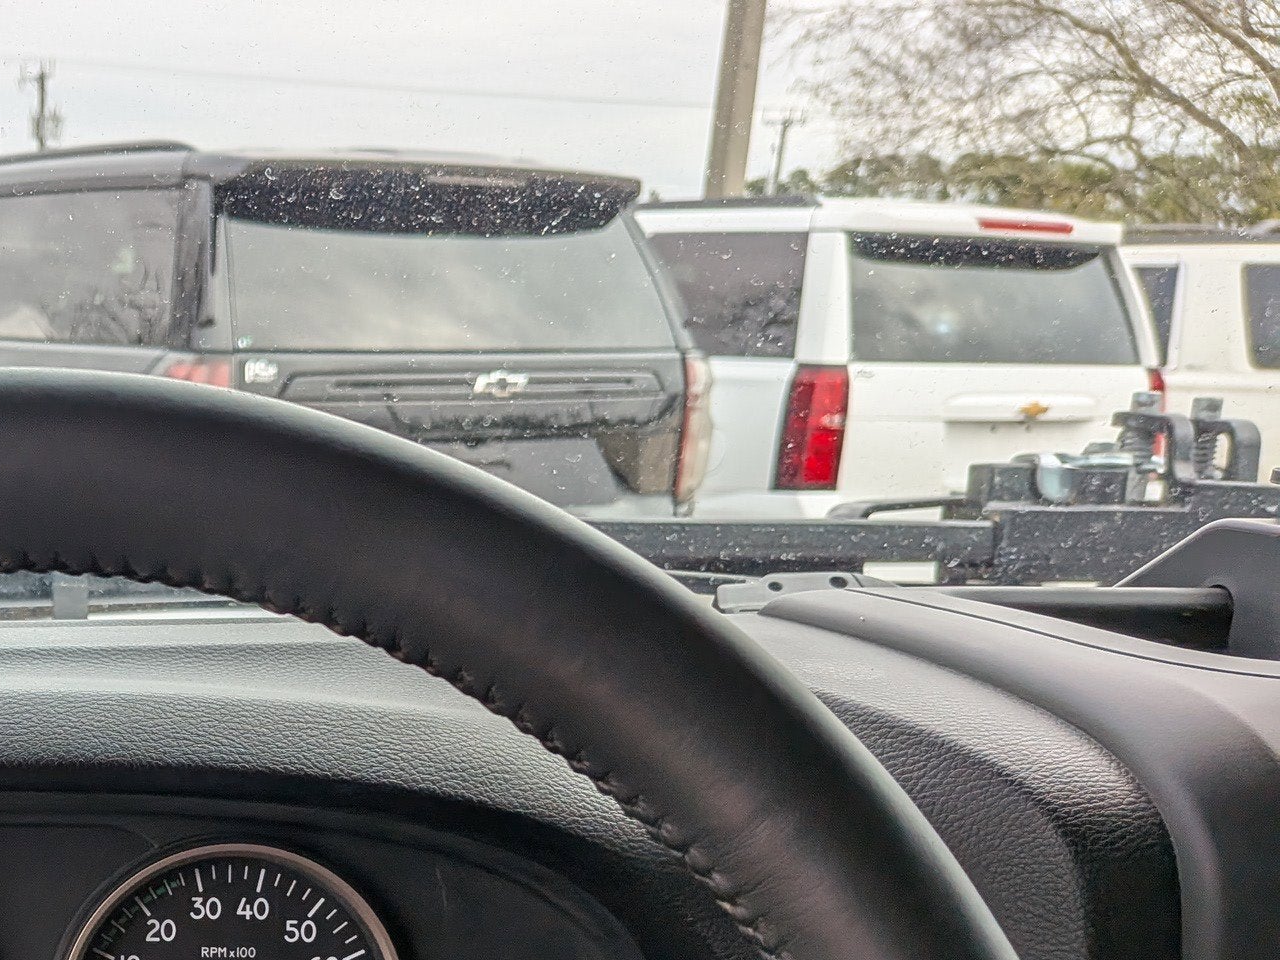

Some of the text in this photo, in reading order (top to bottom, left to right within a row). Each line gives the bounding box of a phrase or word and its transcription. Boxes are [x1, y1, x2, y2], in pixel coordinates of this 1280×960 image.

[189, 896, 222, 920] 30
[236, 897, 270, 921] 40
[145, 918, 177, 942] 20
[283, 919, 317, 943] 50
